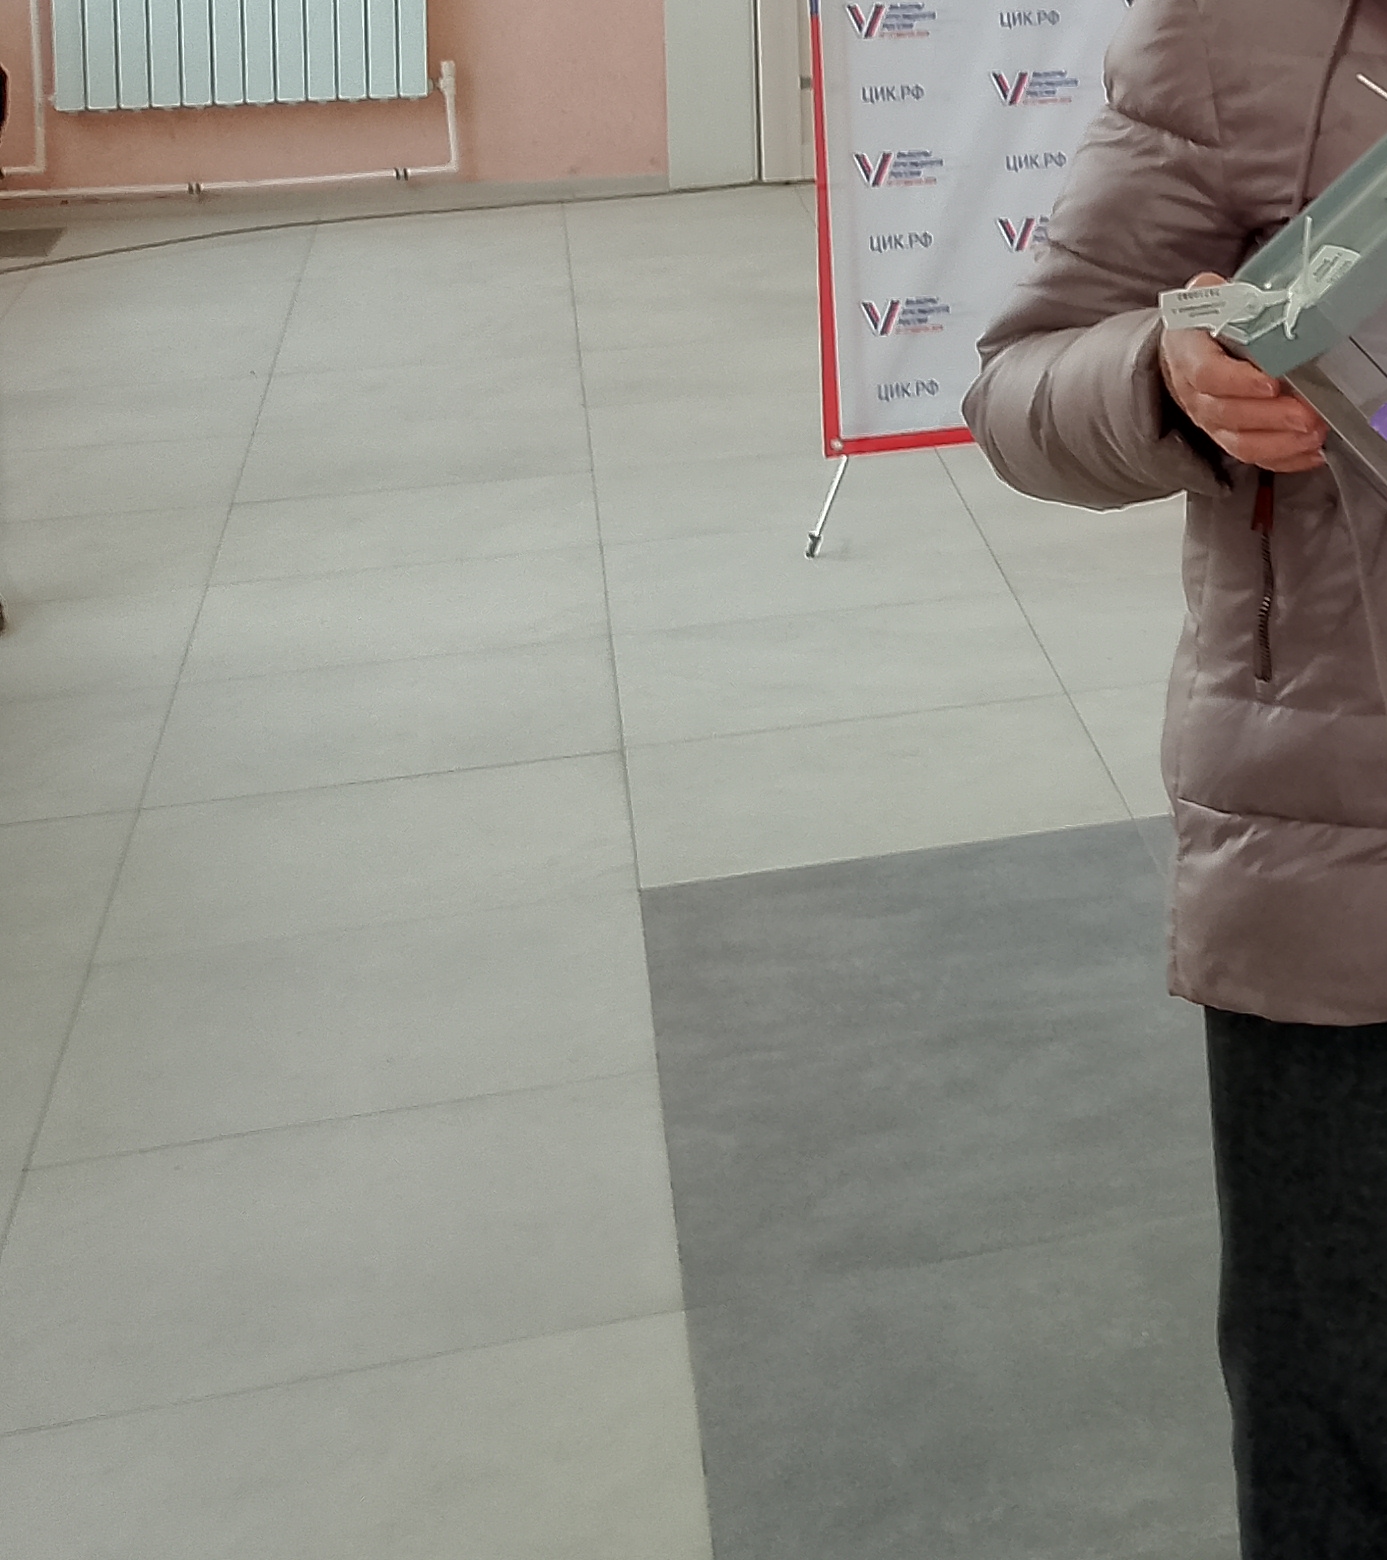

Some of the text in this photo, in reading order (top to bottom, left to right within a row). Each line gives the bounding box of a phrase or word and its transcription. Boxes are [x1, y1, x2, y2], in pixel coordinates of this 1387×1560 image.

[1000, 10, 1059, 29] ЦИК.РФ
[862, 85, 924, 104] ЦИК.РФ
[1006, 152, 1066, 172] ЦИК.РФ
[870, 232, 932, 252] ЦИК.РФ
[878, 380, 938, 400] ЦИК.РФ
